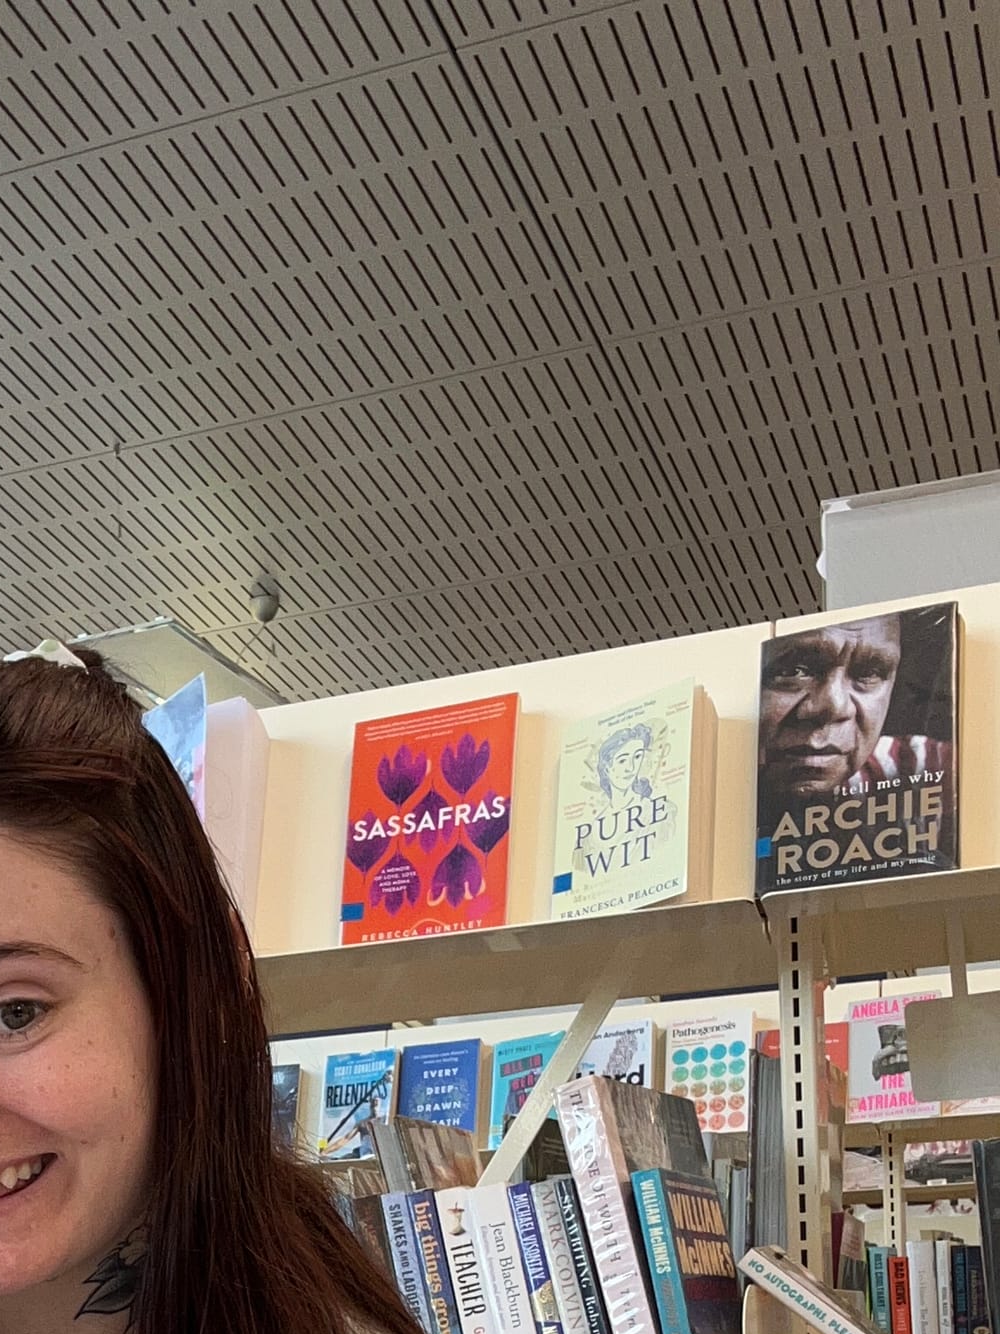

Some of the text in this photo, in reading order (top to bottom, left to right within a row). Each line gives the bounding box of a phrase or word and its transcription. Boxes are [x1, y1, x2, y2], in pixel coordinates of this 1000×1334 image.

[841, 769, 945, 796] tell me why
[353, 796, 506, 842] SASSAFRAS
[574, 795, 669, 850] PURE
[772, 785, 943, 842] ARCHIE
[584, 831, 657, 878] WIT
[777, 821, 939, 875] ROACH
[627, 878, 680, 902] PEACOCK
[776, 877, 791, 886] the
[794, 873, 818, 884] story
[821, 869, 831, 879] of
[834, 868, 848, 879] my
[851, 864, 867, 874] life
[870, 861, 887, 870] and
[891, 859, 905, 870] my
[361, 919, 483, 942] REBECCA HUNTLEY
[672, 1021, 737, 1038] Pathogenesis
[852, 1000, 900, 1019] ANGELA
[423, 1067, 459, 1079] EVERY
[426, 1085, 459, 1096] DEEP-
[880, 1072, 906, 1090] THE
[416, 1101, 462, 1113] DRAWN
[414, 1200, 431, 1232] big
[513, 1192, 535, 1235] MICHAEL
[639, 1179, 664, 1229] WILLIAM
[667, 1190, 727, 1236] WILLIAM
[388, 1203, 411, 1268] SHAKES AND
[536, 1185, 584, 1330] MARK COLVIN
[561, 1194, 591, 1289] SKYWRITING
[650, 1227, 672, 1275] McINNES
[675, 1235, 736, 1278] McINNES
[421, 1239, 442, 1293] things
[450, 1239, 487, 1318] TEACHER
[489, 1221, 507, 1252] Jean
[499, 1256, 522, 1329] Blackburn
[894, 1261, 906, 1306] BAD NEWS
[748, 1259, 764, 1273] NO
[763, 1270, 827, 1324] AUTOGRAPHS,
